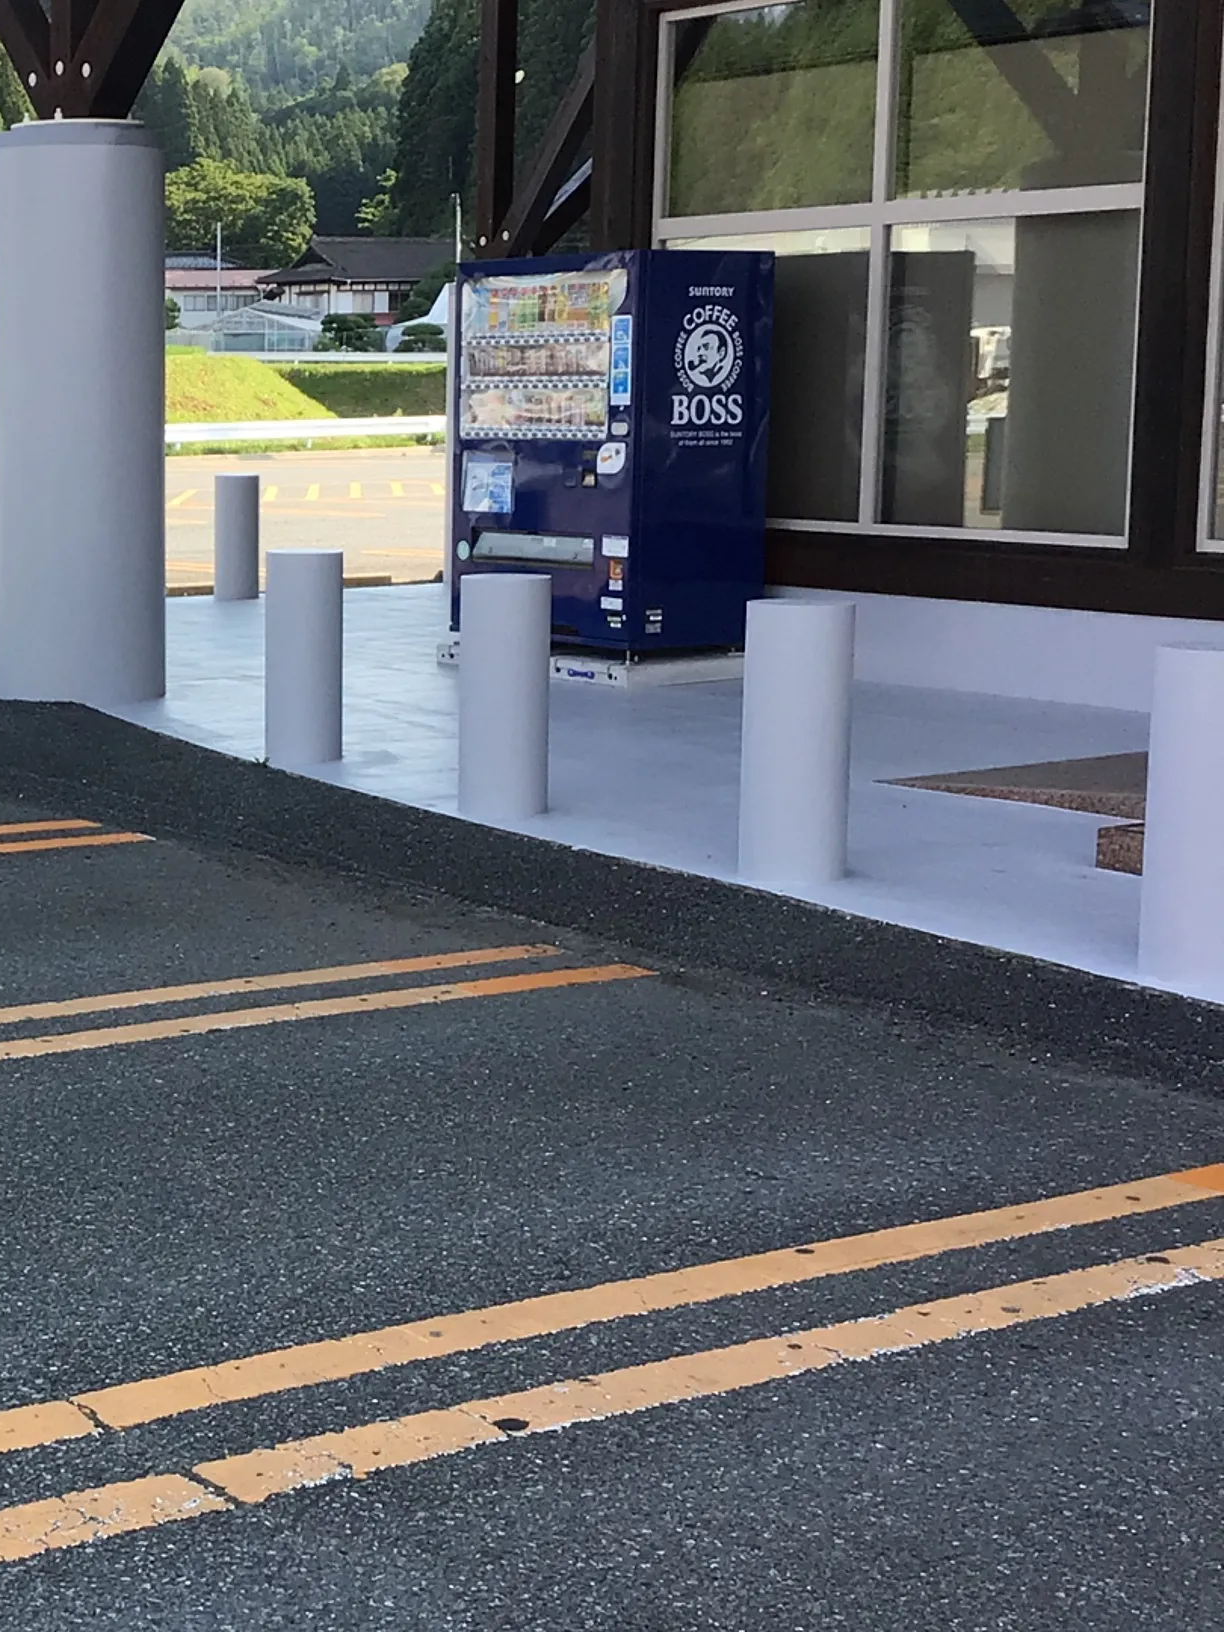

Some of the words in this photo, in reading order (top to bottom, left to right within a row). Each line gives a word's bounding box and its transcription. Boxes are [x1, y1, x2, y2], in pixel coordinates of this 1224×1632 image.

[688, 286, 735, 297] SUNTORY
[683, 305, 739, 331] COFFEE
[674, 331, 688, 369] COFFEE
[732, 331, 744, 358] BOSS
[670, 394, 743, 425] BOSS
